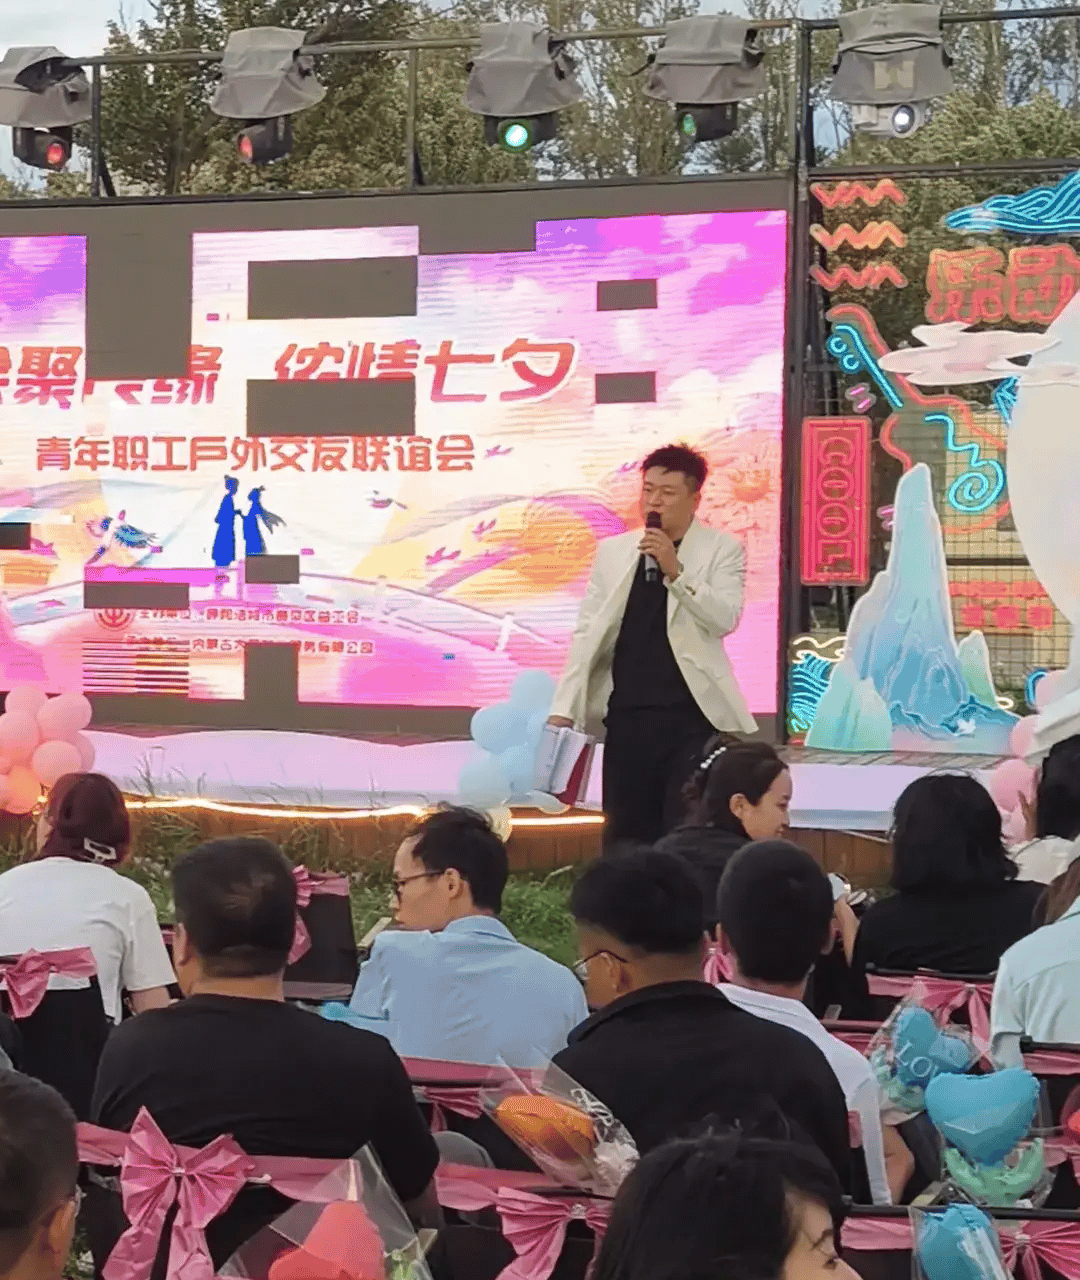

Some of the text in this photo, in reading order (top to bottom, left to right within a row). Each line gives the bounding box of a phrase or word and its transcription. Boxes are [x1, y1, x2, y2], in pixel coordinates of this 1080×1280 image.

[36, 434, 476, 472] 青年职工户外交友联谊会
